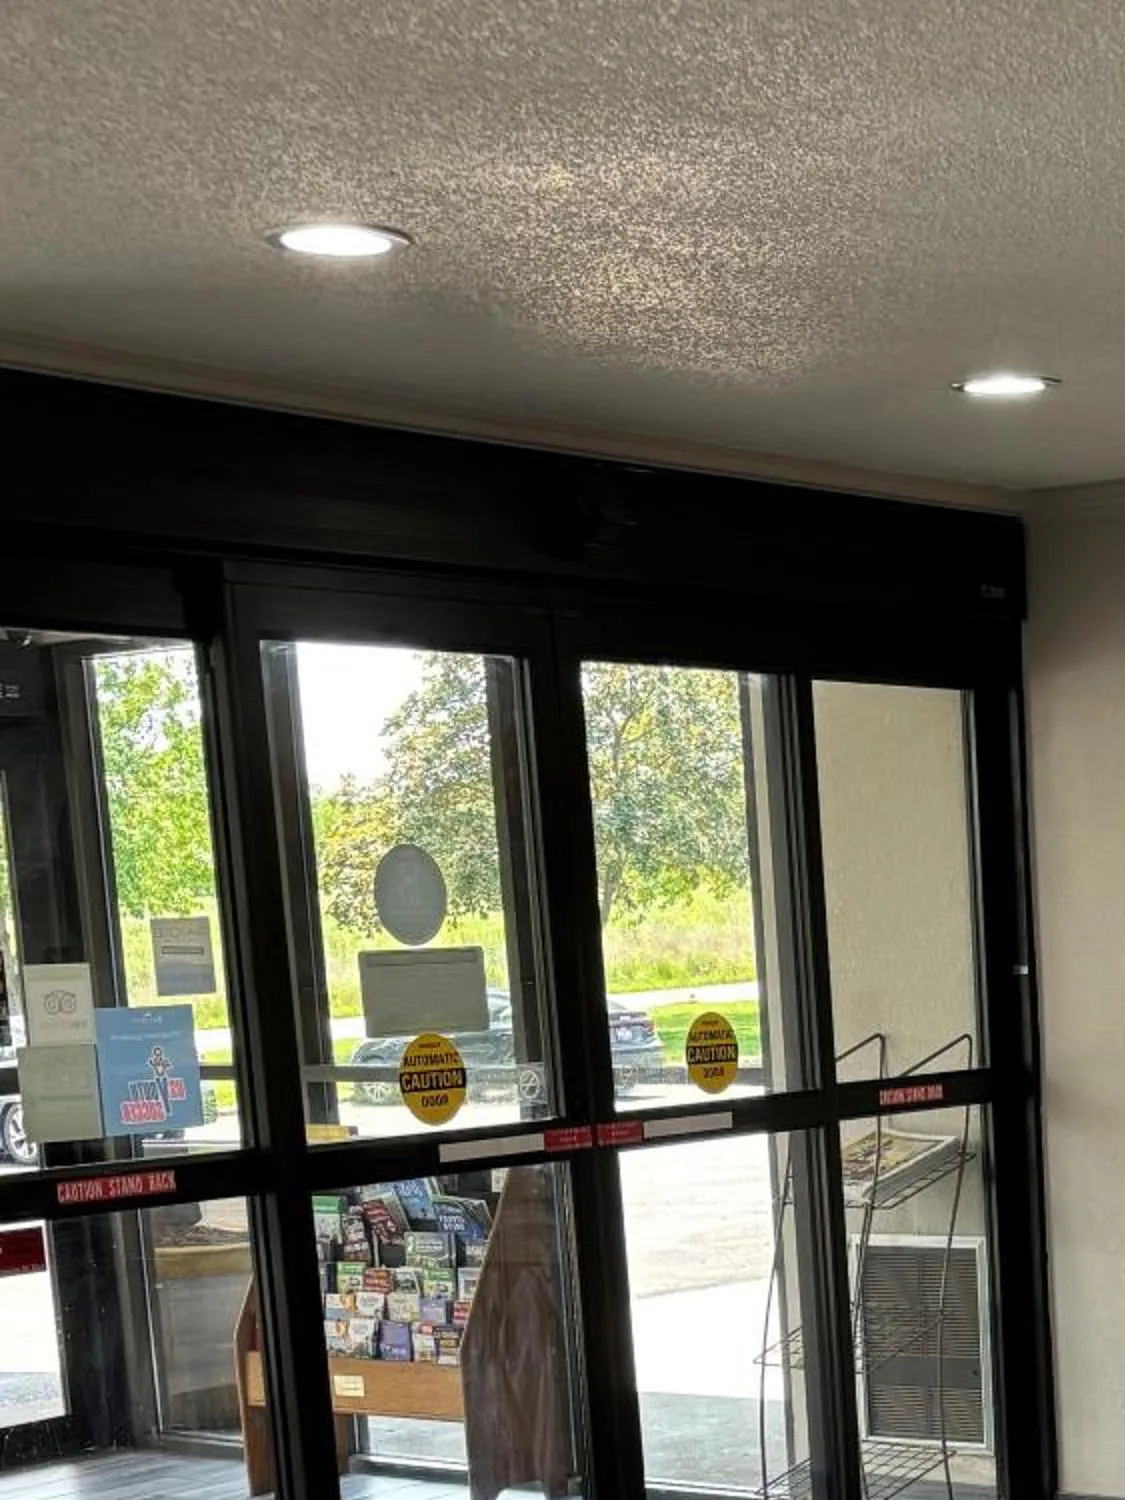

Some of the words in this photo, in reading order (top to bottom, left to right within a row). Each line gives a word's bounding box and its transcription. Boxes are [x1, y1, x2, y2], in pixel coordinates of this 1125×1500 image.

[403, 1050, 461, 1067] AUTOMATIC
[687, 1045, 736, 1063] CAUTION
[401, 1069, 463, 1092] CAUTION
[421, 1094, 449, 1108] DOOR
